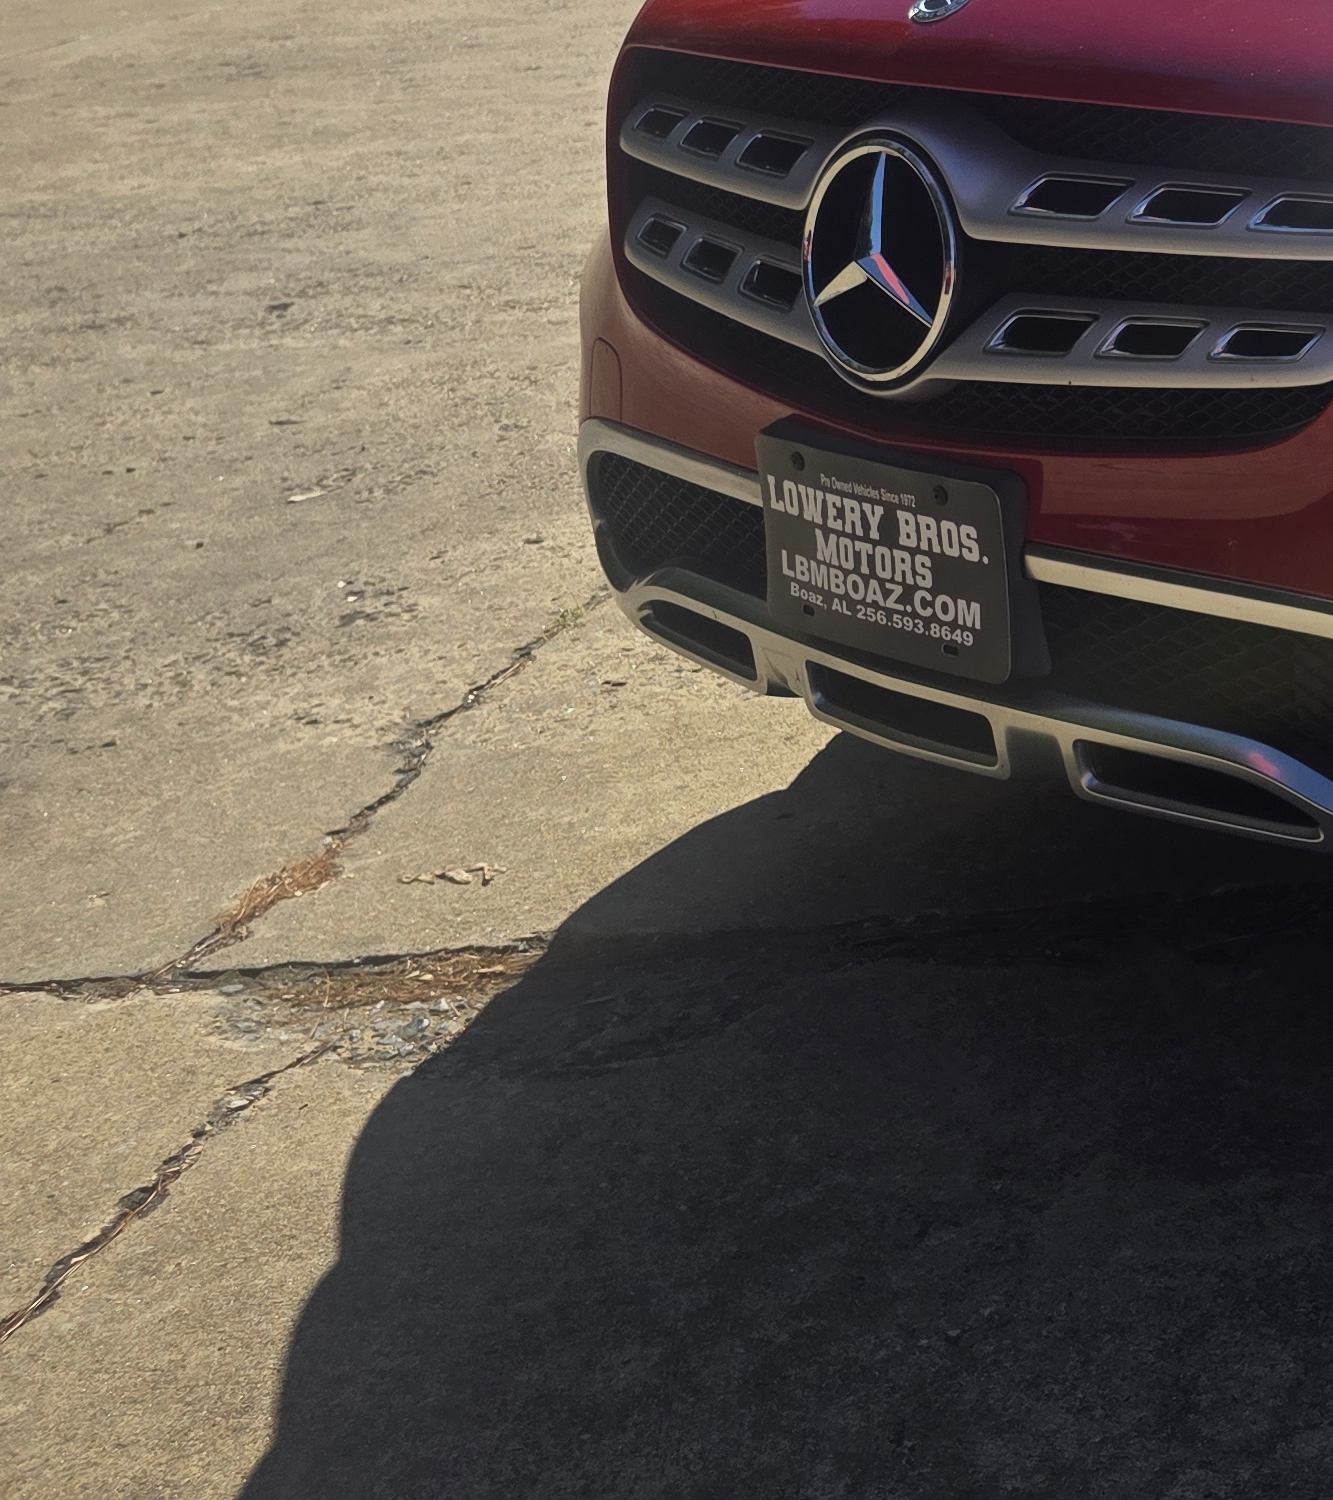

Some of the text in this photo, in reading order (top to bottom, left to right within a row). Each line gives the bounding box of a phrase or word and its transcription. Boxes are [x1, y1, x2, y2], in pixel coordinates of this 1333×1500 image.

[767, 474, 989, 565] LOWERY BROS.
[831, 476, 852, 494] Owned
[853, 482, 880, 500] Vehicles
[880, 488, 899, 504] Since
[900, 493, 917, 508] 1972
[781, 549, 981, 630] LBMBOAZ.COM
[815, 528, 933, 589] MOTORS
[790, 581, 974, 647] Boaz, AL 256.593.8649
